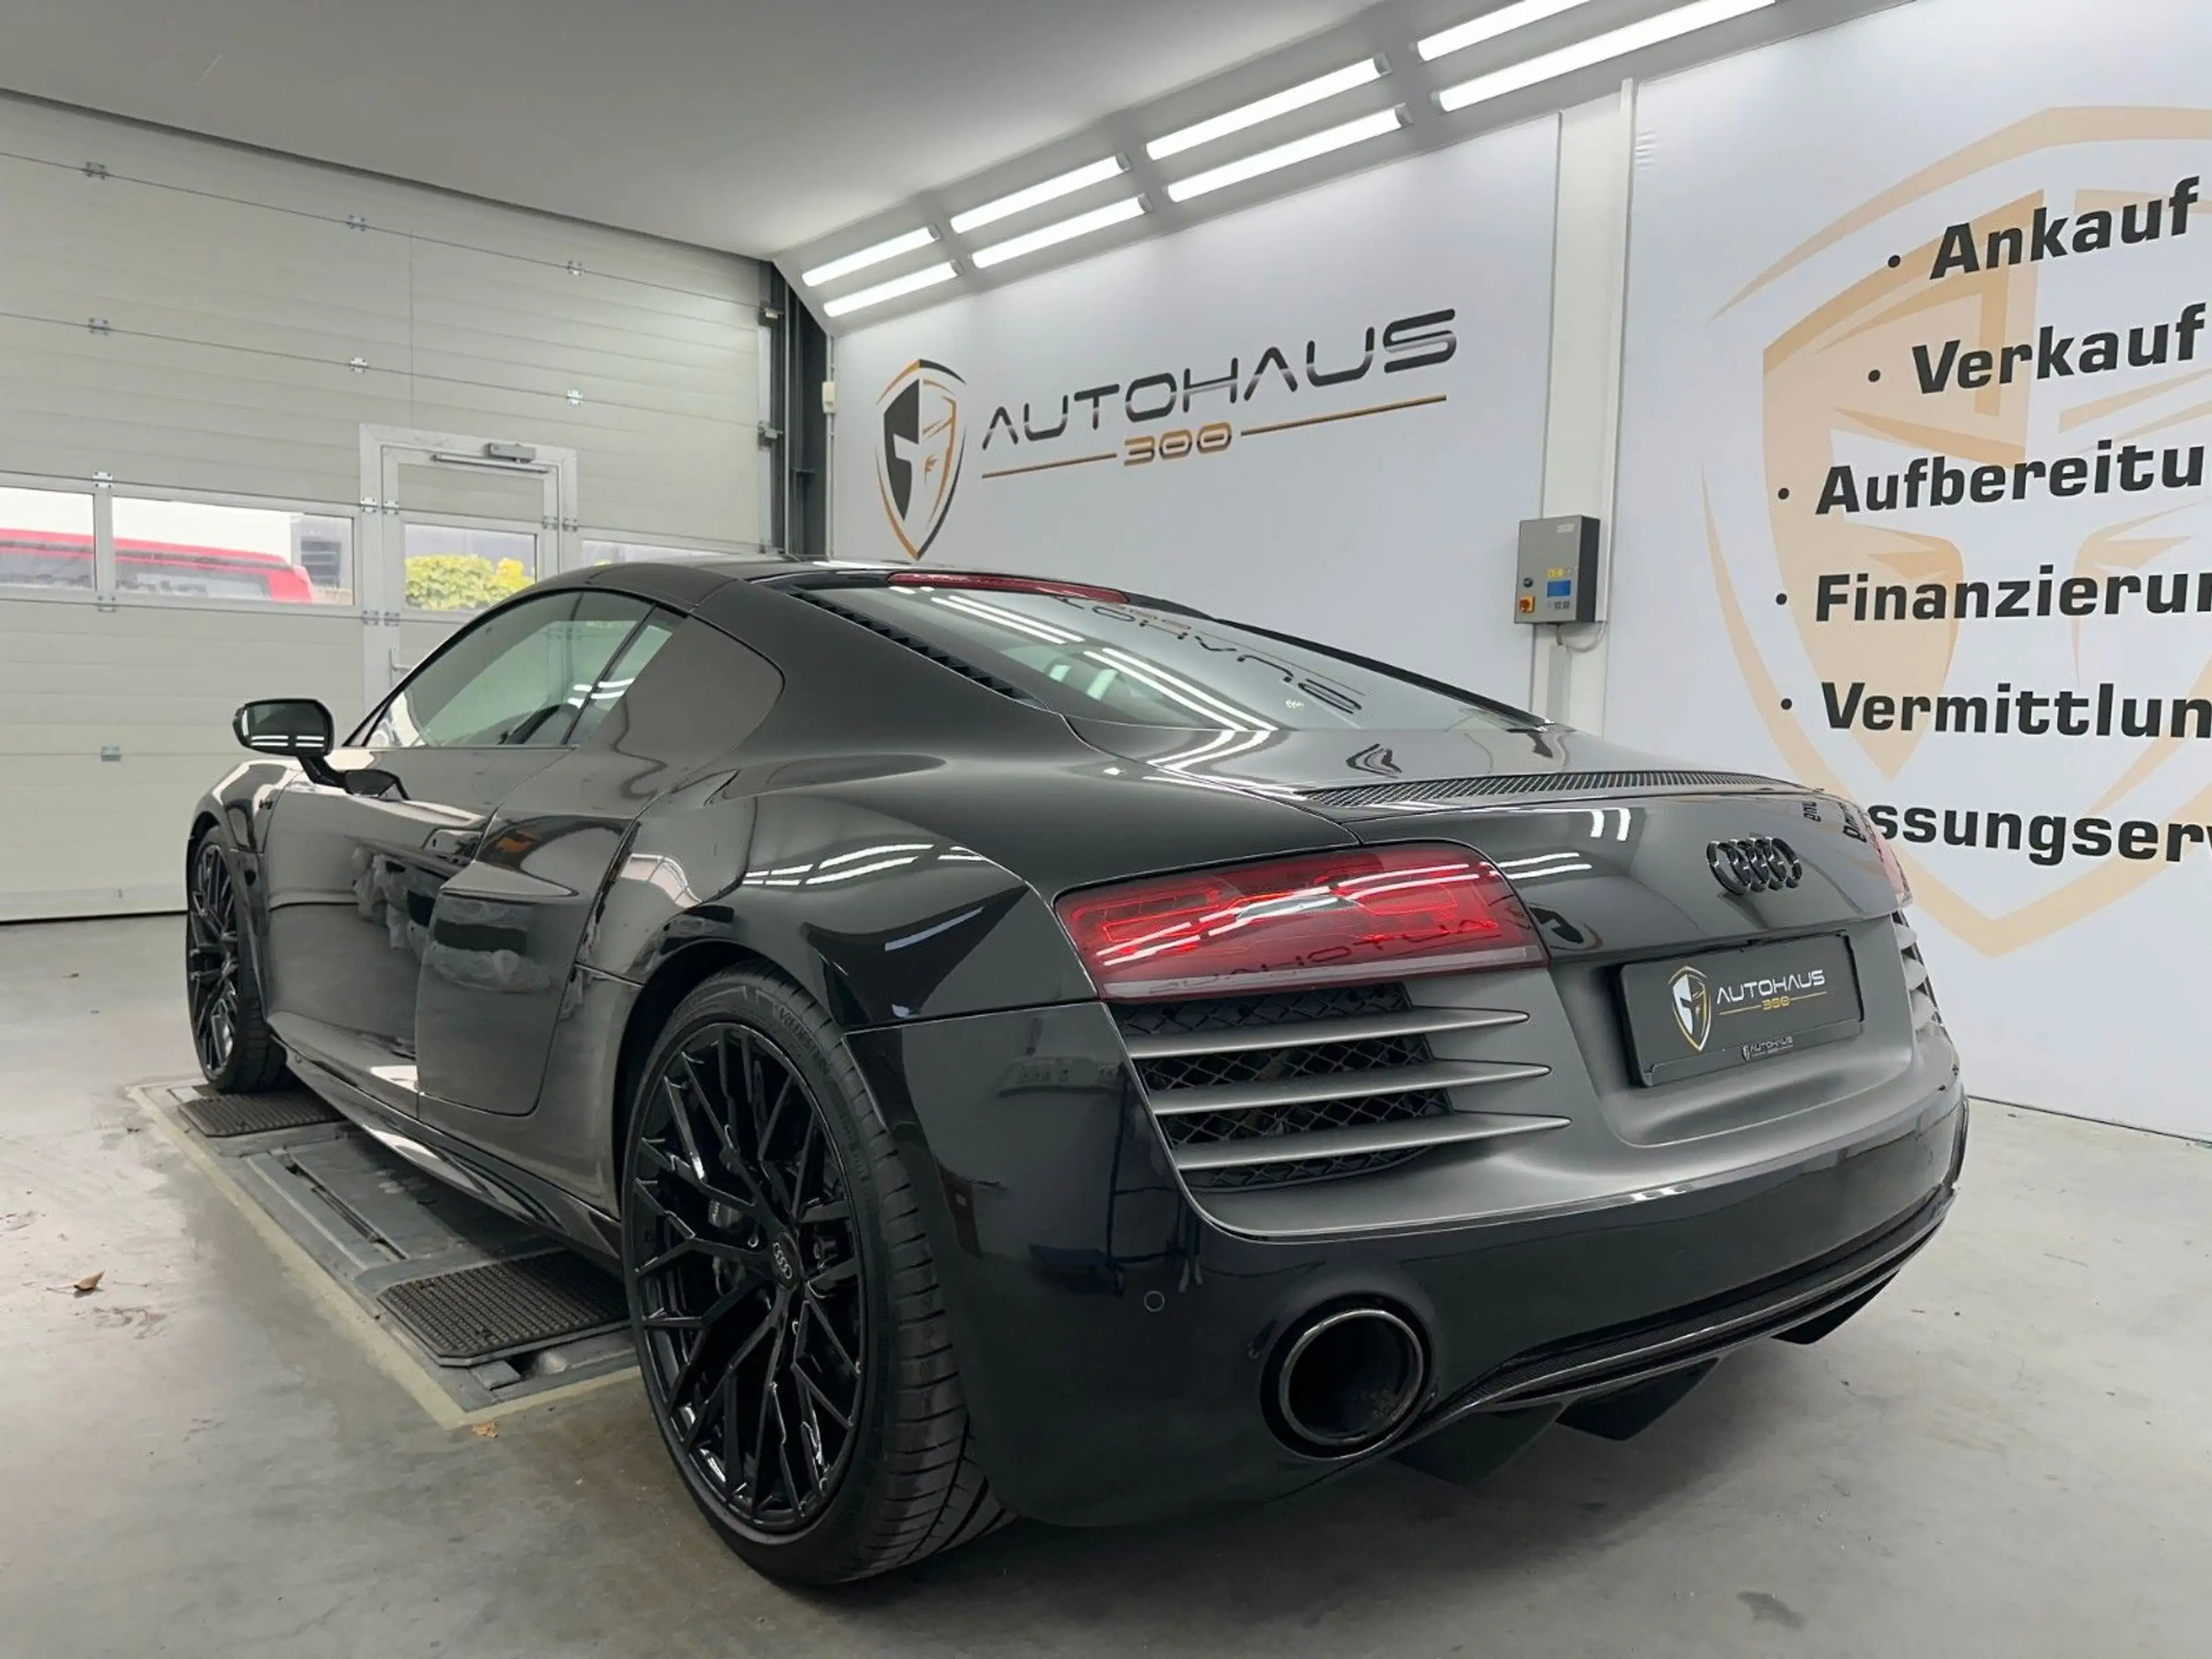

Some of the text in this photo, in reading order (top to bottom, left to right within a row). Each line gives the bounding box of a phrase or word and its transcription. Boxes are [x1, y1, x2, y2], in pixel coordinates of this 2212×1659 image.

[1929, 176, 2199, 280] Ankauf
[982, 308, 1457, 450] AUTOHAUS
[1912, 302, 2206, 394] Verkauf
[1124, 422, 1232, 466] 300
[1815, 439, 2204, 515] Aufbereitu
[1821, 682, 2212, 738] Vermittlun
[1868, 805, 2212, 866] ssungser
[1717, 969, 1825, 1004] AUTOHAUS
